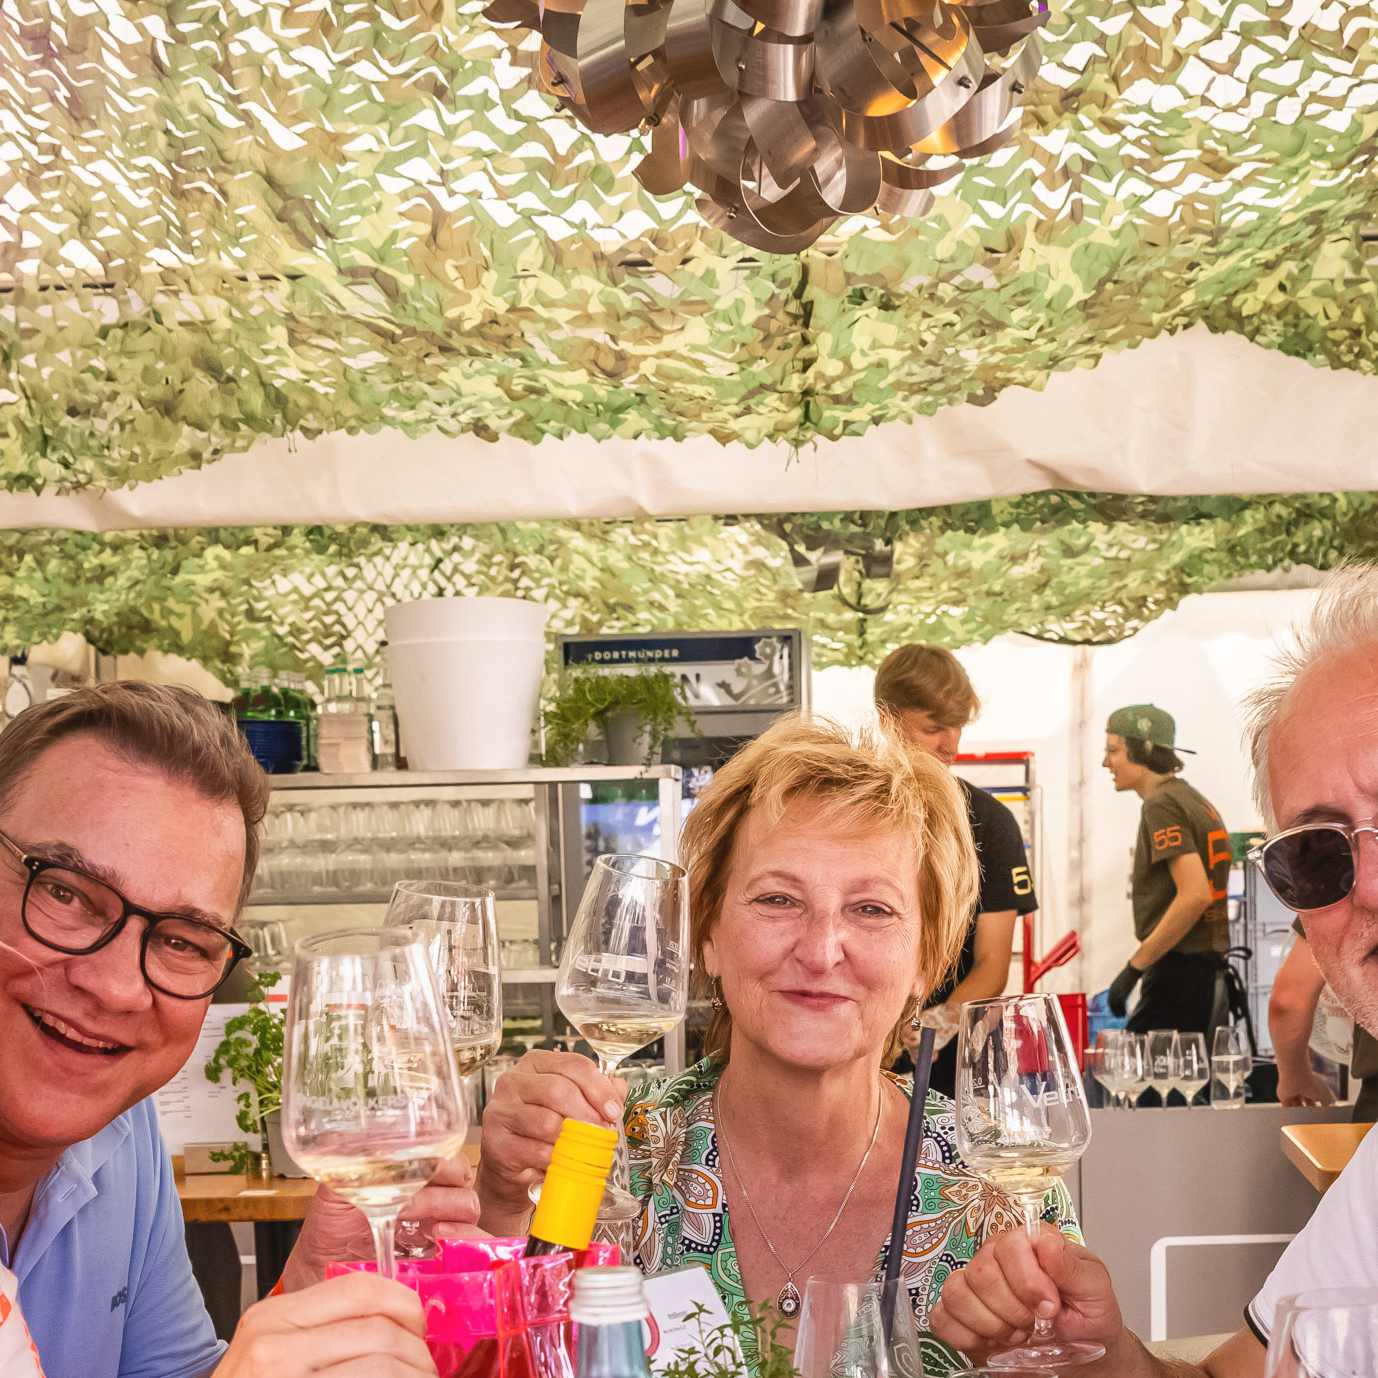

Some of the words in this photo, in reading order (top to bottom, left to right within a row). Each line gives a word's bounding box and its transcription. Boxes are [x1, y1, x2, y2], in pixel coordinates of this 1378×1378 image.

[594, 648, 680, 662] DORTMUNDER
[1153, 826, 1182, 850] 55
[1011, 866, 1034, 895] 5
